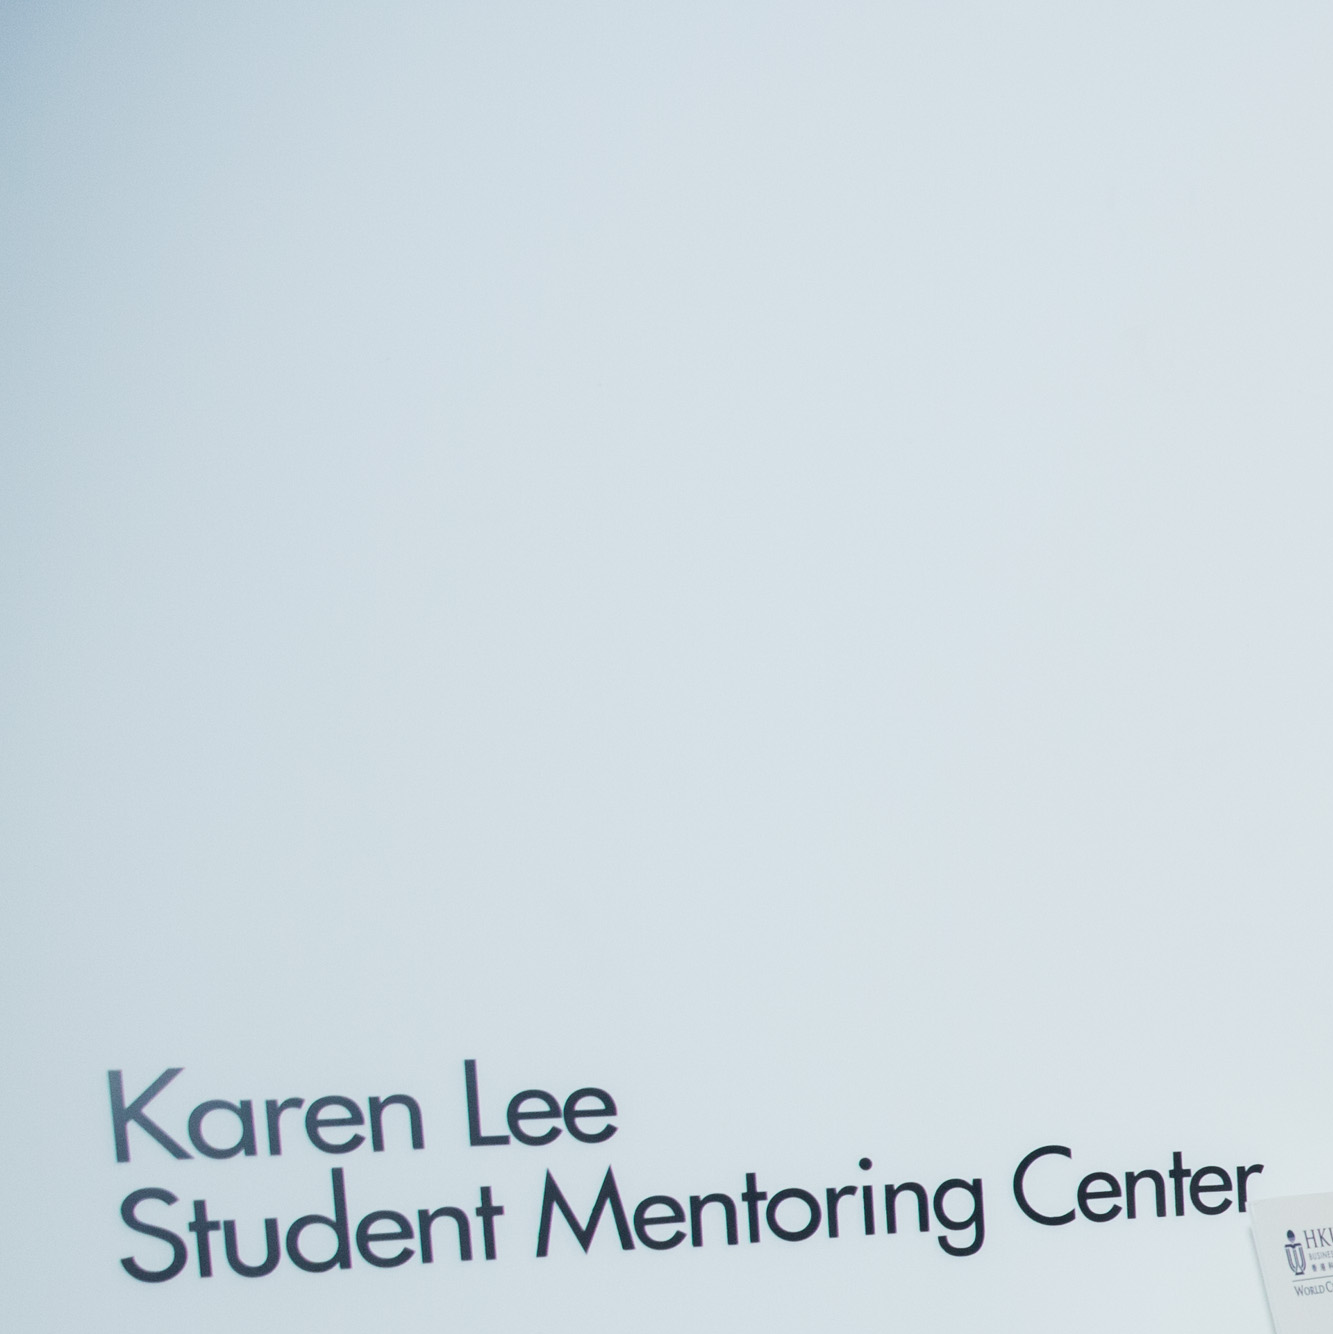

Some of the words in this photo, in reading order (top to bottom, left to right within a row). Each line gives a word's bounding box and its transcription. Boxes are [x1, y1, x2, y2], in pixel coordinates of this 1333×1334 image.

[107, 1066, 425, 1163] Karen
[463, 1058, 619, 1147] Lee
[120, 1168, 504, 1284] Student
[537, 1157, 984, 1259] Mentoring
[1011, 1144, 1264, 1228] Center
